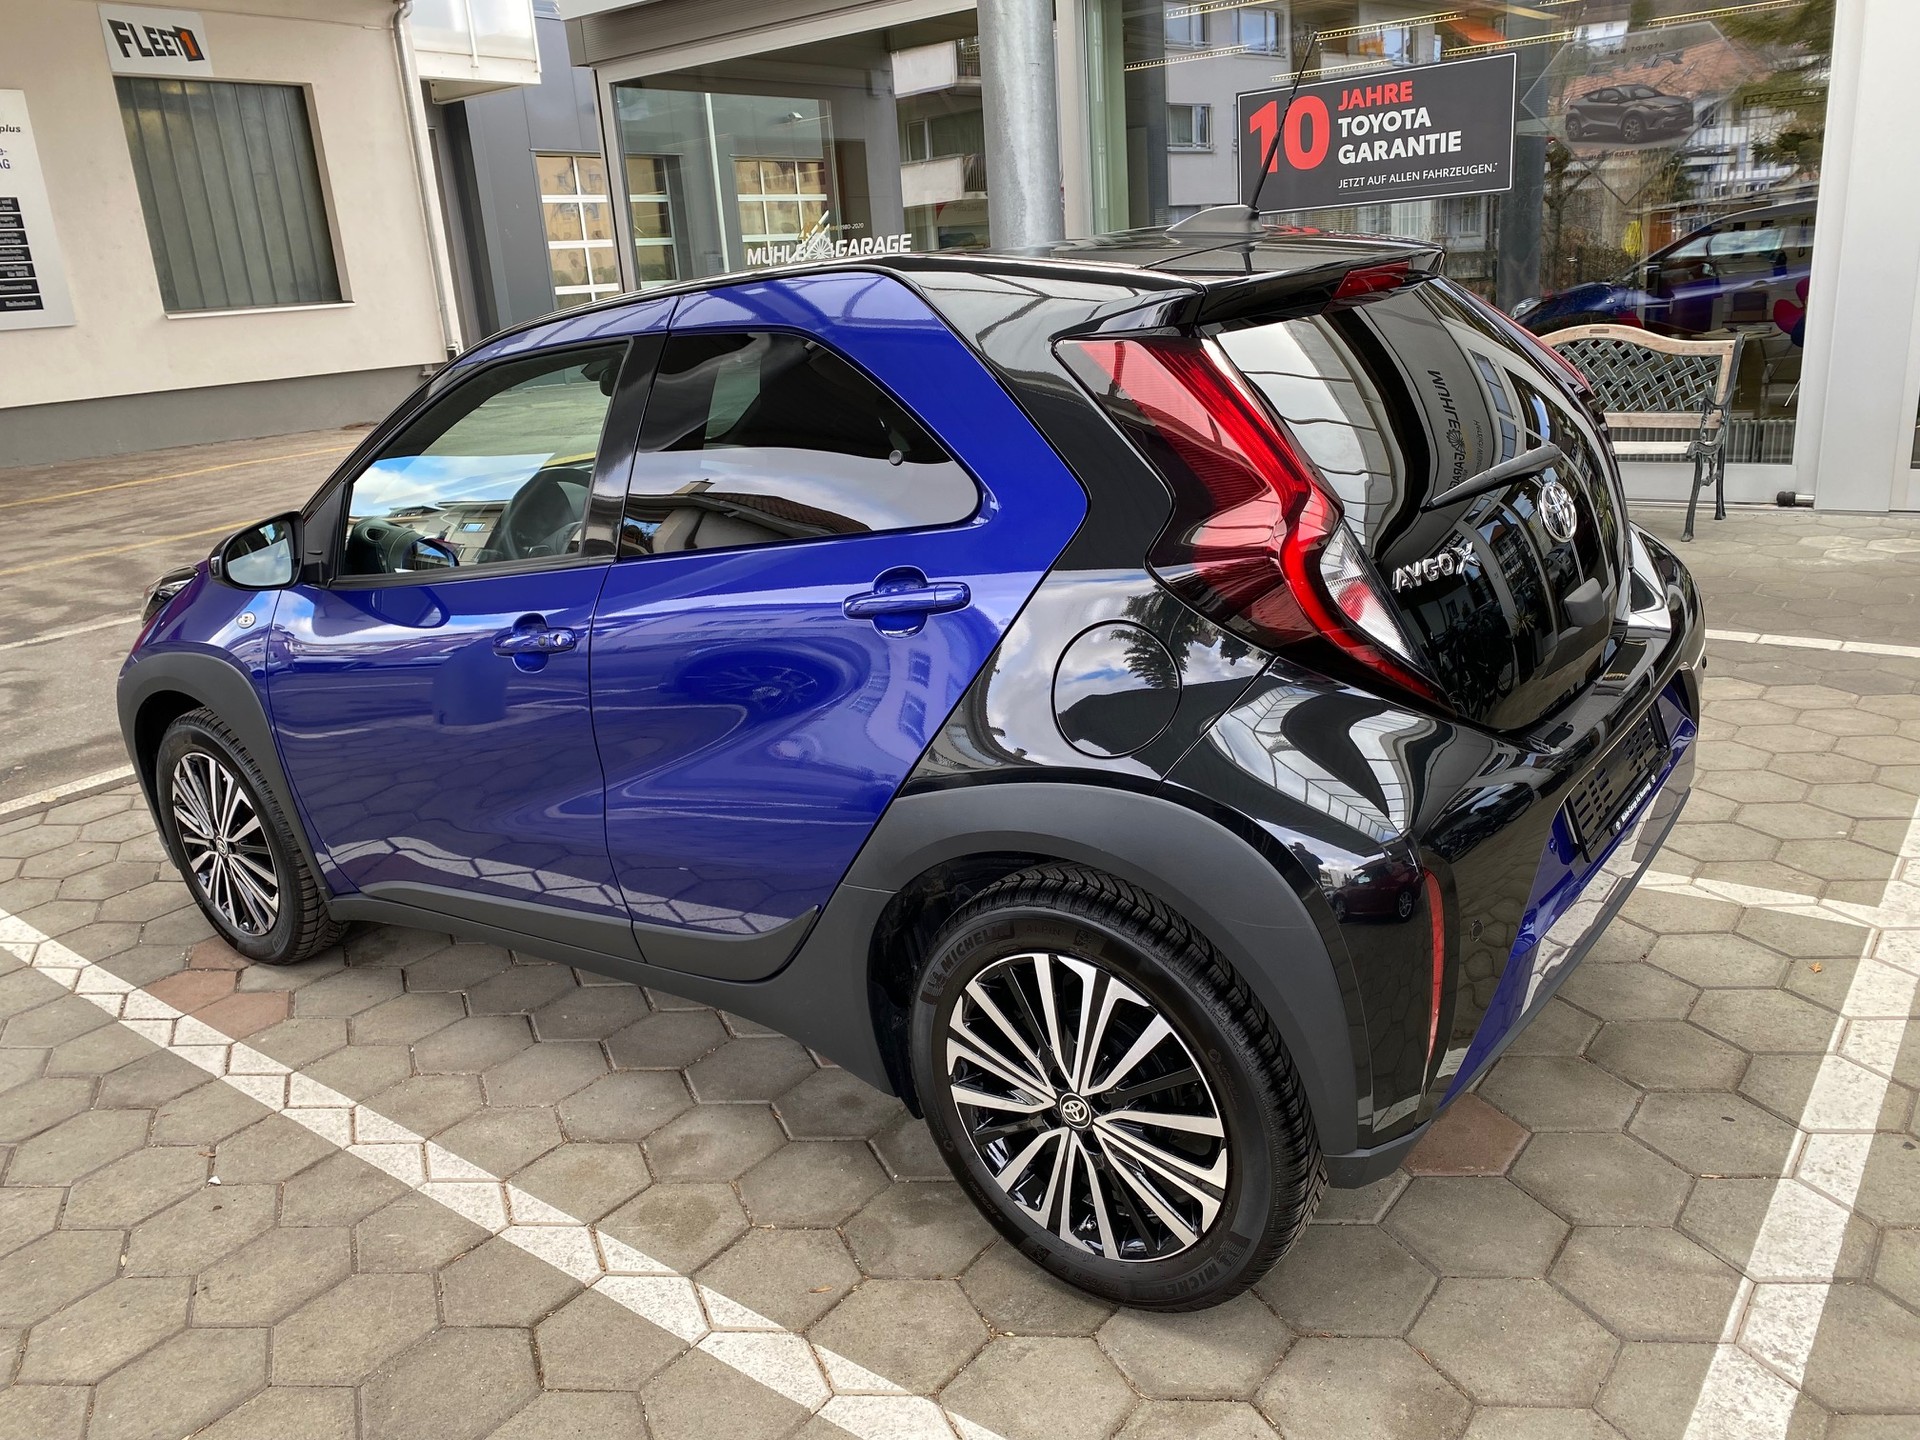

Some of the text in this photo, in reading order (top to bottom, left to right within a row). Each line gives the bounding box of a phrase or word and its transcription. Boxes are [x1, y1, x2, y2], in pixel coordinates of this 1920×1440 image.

[107, 19, 202, 60] FLEET1
[1338, 80, 1413, 111] JAHRE
[1250, 95, 1330, 173] 10
[1338, 106, 1431, 138] TOYOTA
[1338, 130, 1462, 165] GARANTIE
[1338, 175, 1365, 189] JETZT
[1367, 174, 1386, 186] AUF
[1389, 171, 1419, 184] ALLEN
[835, 233, 912, 258] GARAGE
[1392, 553, 1455, 593] AYGO
[1452, 541, 1481, 575] X
